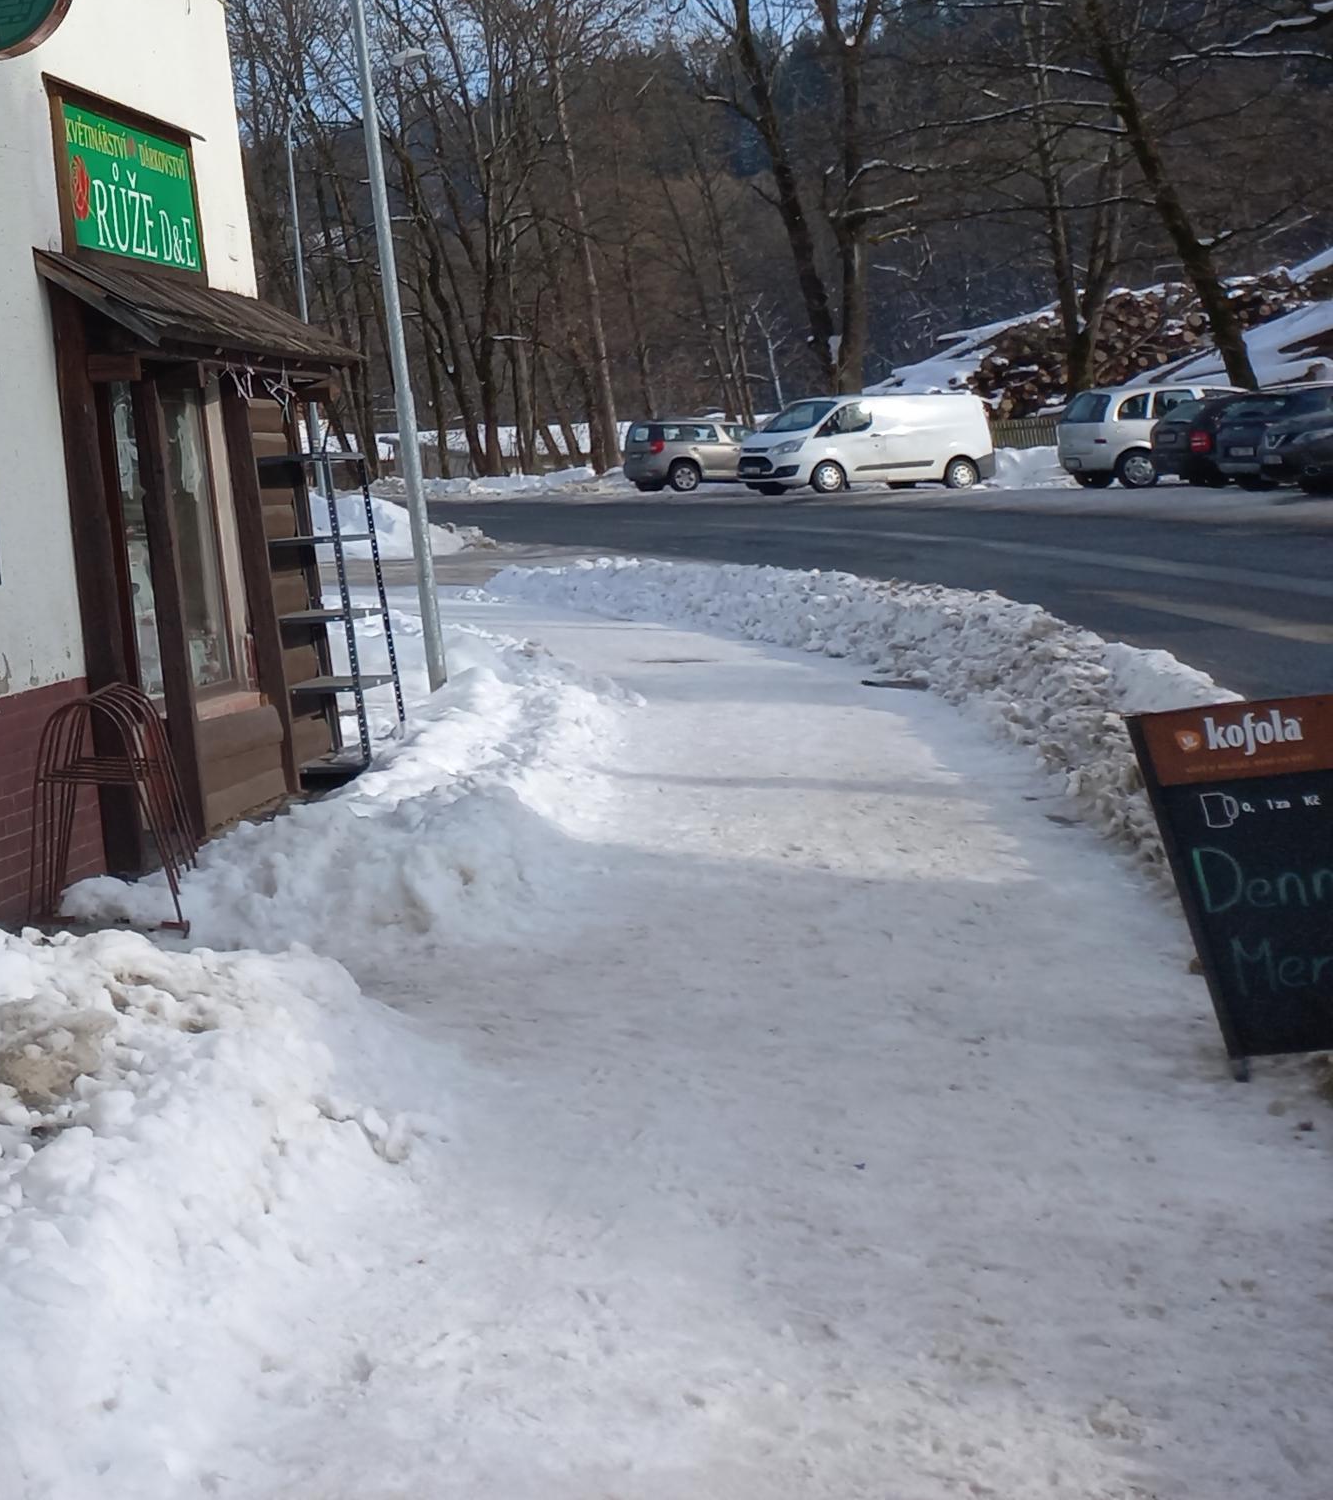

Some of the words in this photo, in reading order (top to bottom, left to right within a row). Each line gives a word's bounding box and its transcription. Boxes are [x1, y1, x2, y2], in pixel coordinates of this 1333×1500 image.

[64, 114, 129, 161] KVĚTINÁŘSTVÍ
[138, 140, 186, 181] DÁRKOVSTVÍ
[93, 161, 158, 258] RŮŽE
[159, 209, 196, 267] D&E
[1203, 709, 1304, 756] kofola
